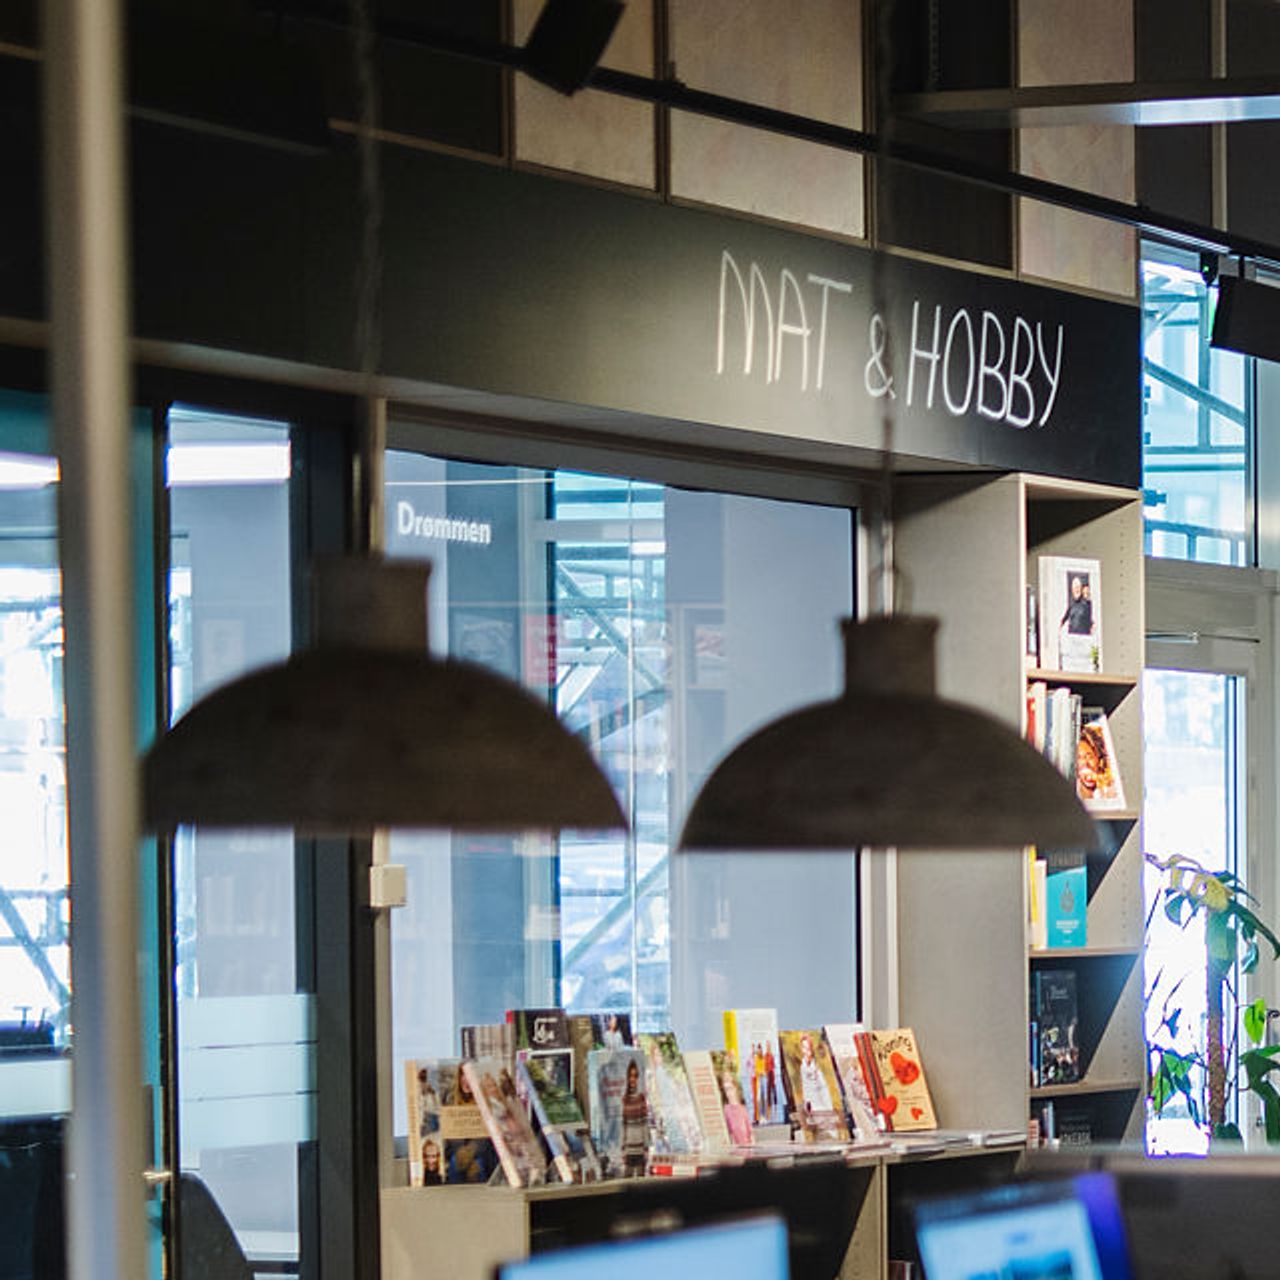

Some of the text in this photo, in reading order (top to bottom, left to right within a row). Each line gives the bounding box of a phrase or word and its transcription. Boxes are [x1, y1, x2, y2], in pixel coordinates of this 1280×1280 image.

[716, 250, 1065, 428] MAT & HOBBY
